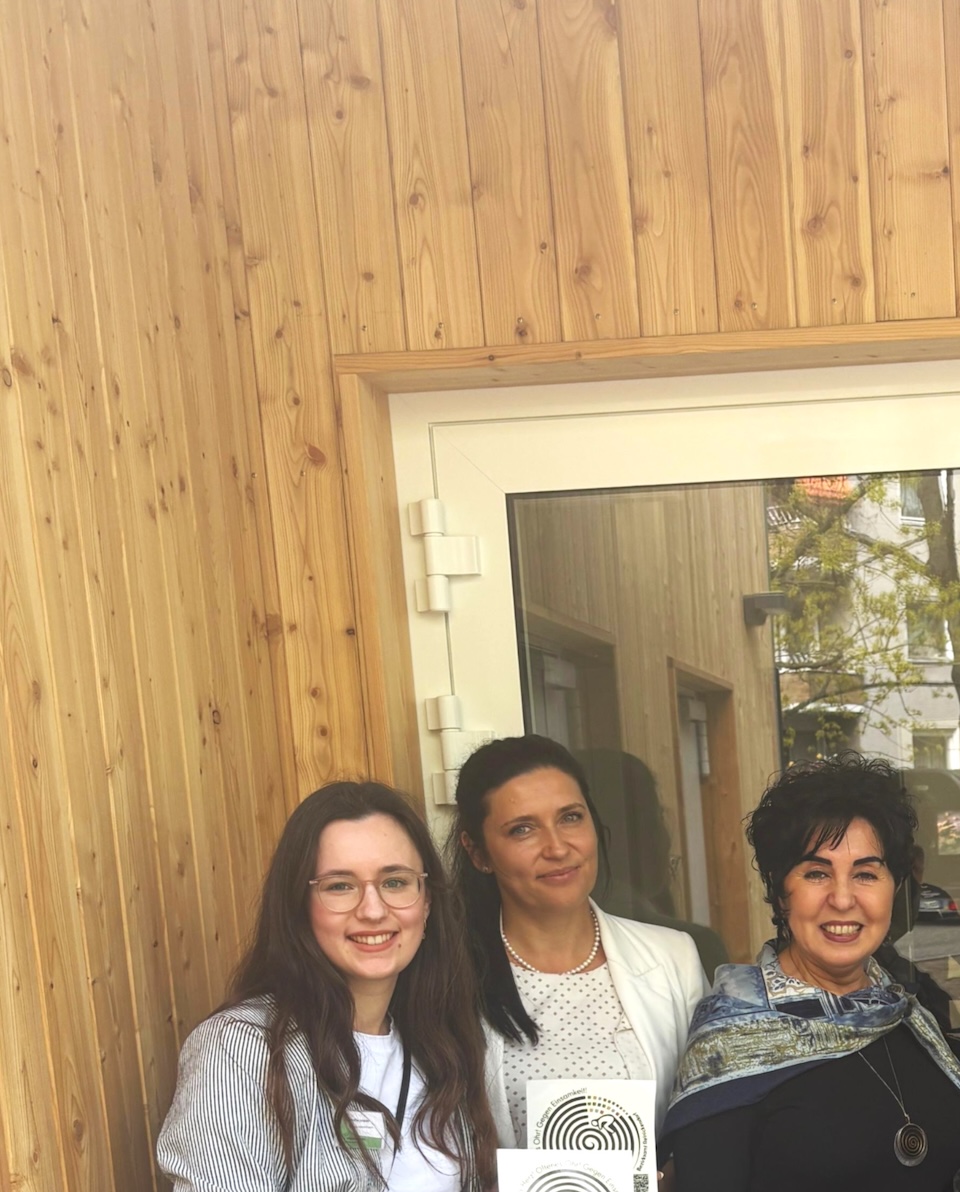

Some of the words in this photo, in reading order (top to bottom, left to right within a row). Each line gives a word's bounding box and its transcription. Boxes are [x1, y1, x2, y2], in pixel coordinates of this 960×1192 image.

[551, 1088, 588, 1107] Einsamkeit!
[536, 1107, 552, 1128] Gegen
[533, 1129, 541, 1145] Ohr!
